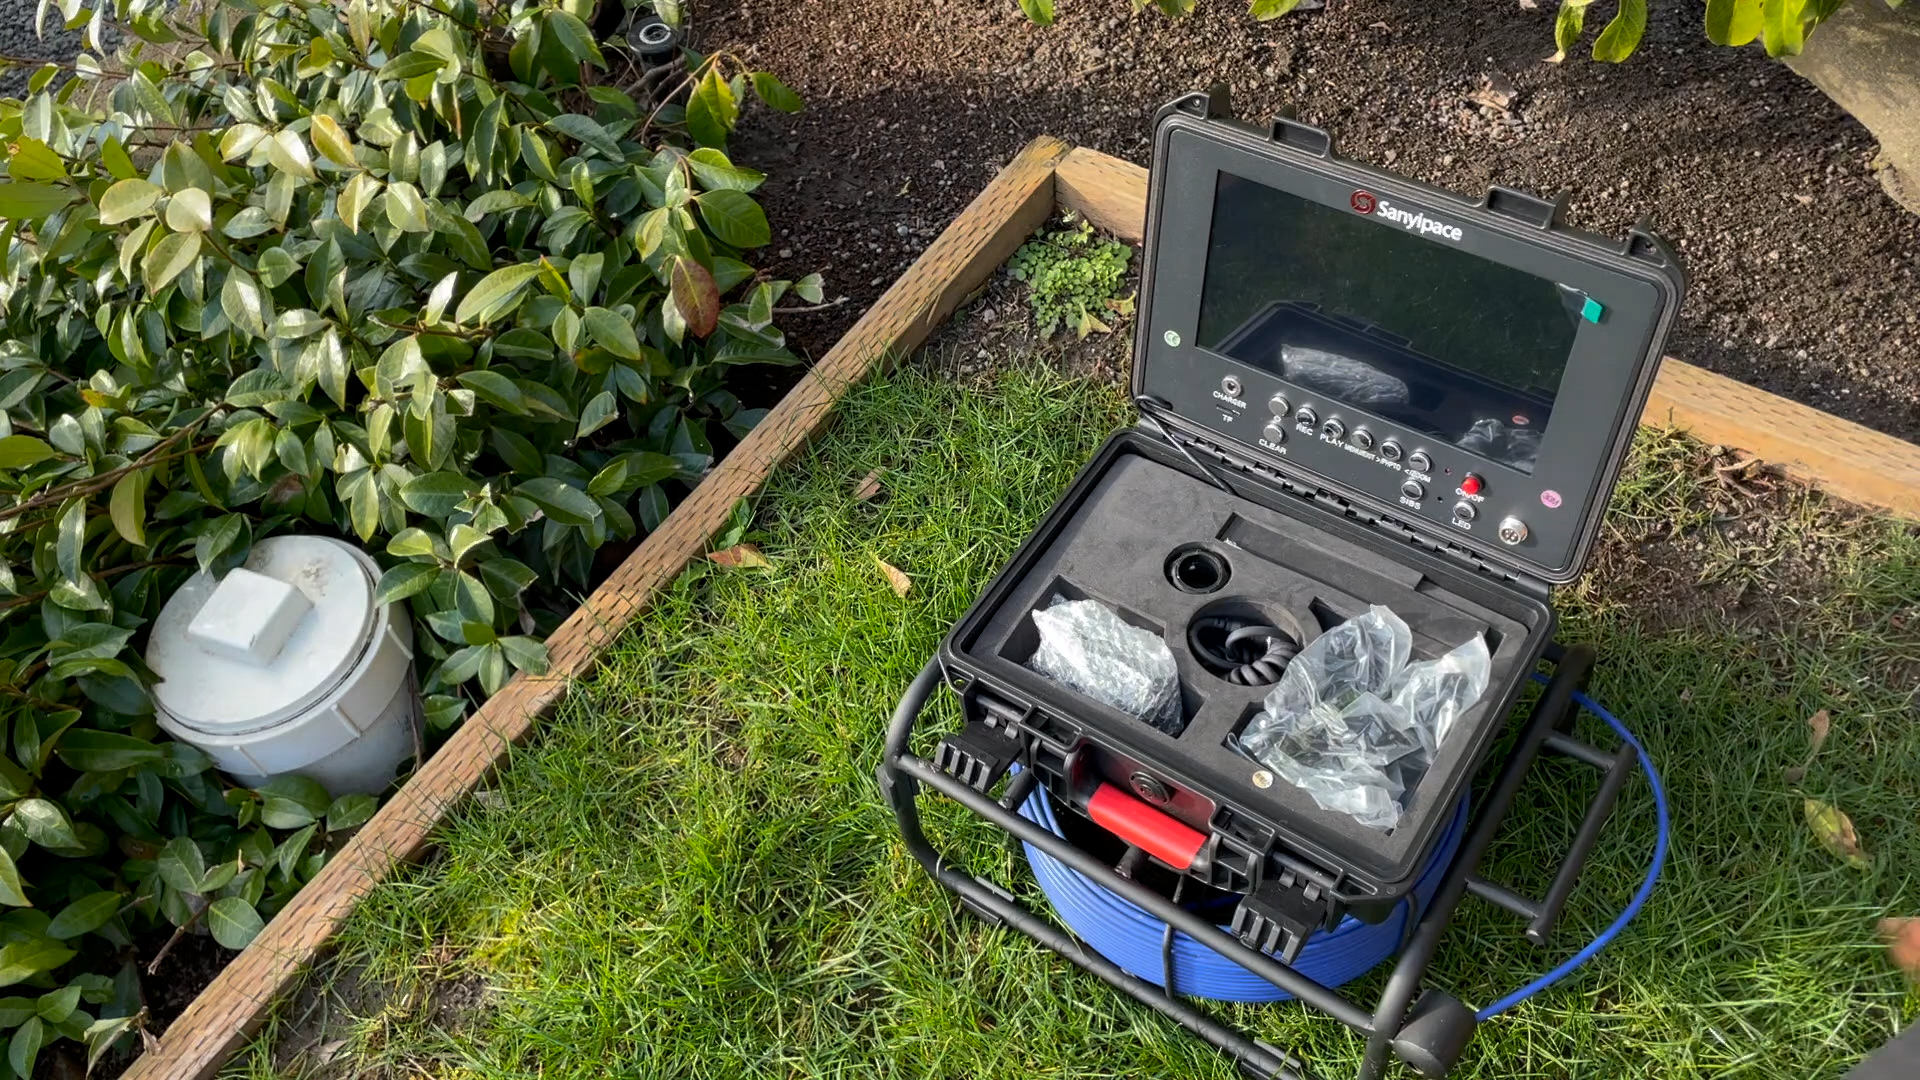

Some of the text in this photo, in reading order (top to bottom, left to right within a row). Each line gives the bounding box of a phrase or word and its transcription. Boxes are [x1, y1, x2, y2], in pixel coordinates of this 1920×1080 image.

[1376, 200, 1463, 241] Sanyipace
[1212, 390, 1247, 409] CHARGER
[1295, 423, 1313, 436] REC
[1258, 438, 1287, 455] CLEAR
[1320, 433, 1344, 449] PLAY
[1451, 517, 1472, 530] LED
